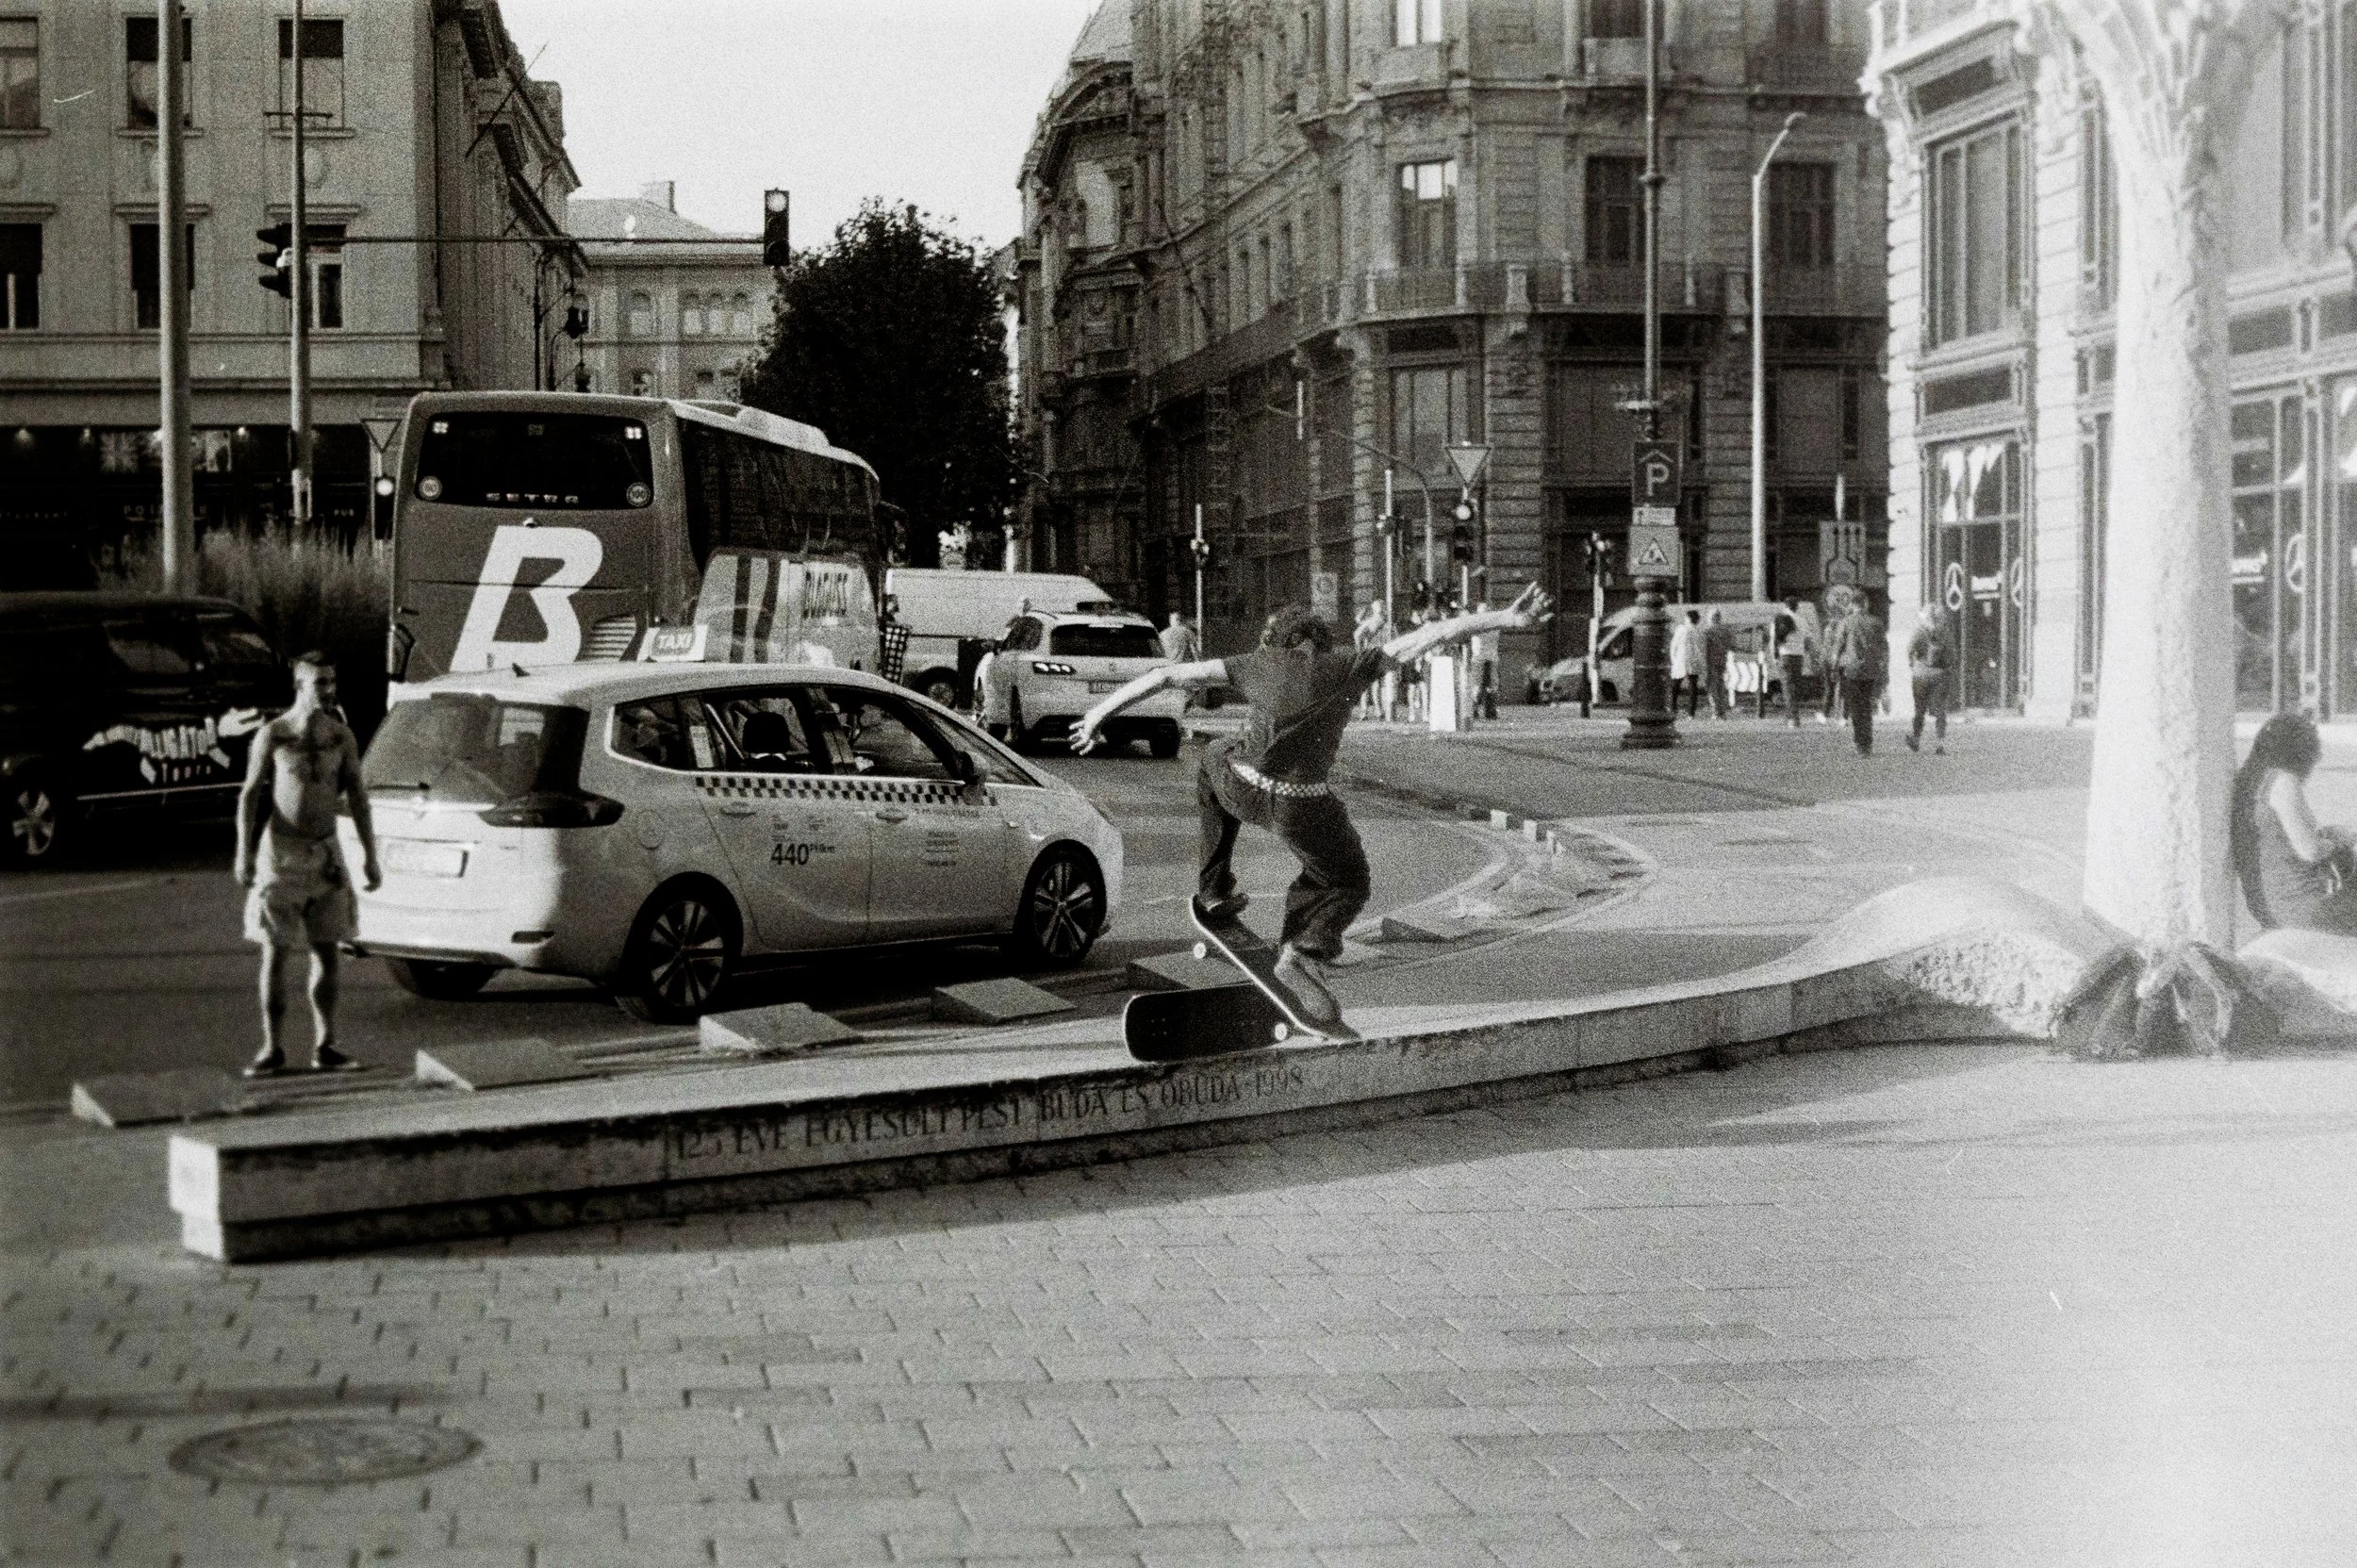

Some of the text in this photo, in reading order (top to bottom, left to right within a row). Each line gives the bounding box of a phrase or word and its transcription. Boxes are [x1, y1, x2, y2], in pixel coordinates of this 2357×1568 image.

[1646, 462, 1670, 497] P
[449, 525, 603, 672] B
[658, 633, 693, 651] TAXI
[771, 843, 810, 866] 440
